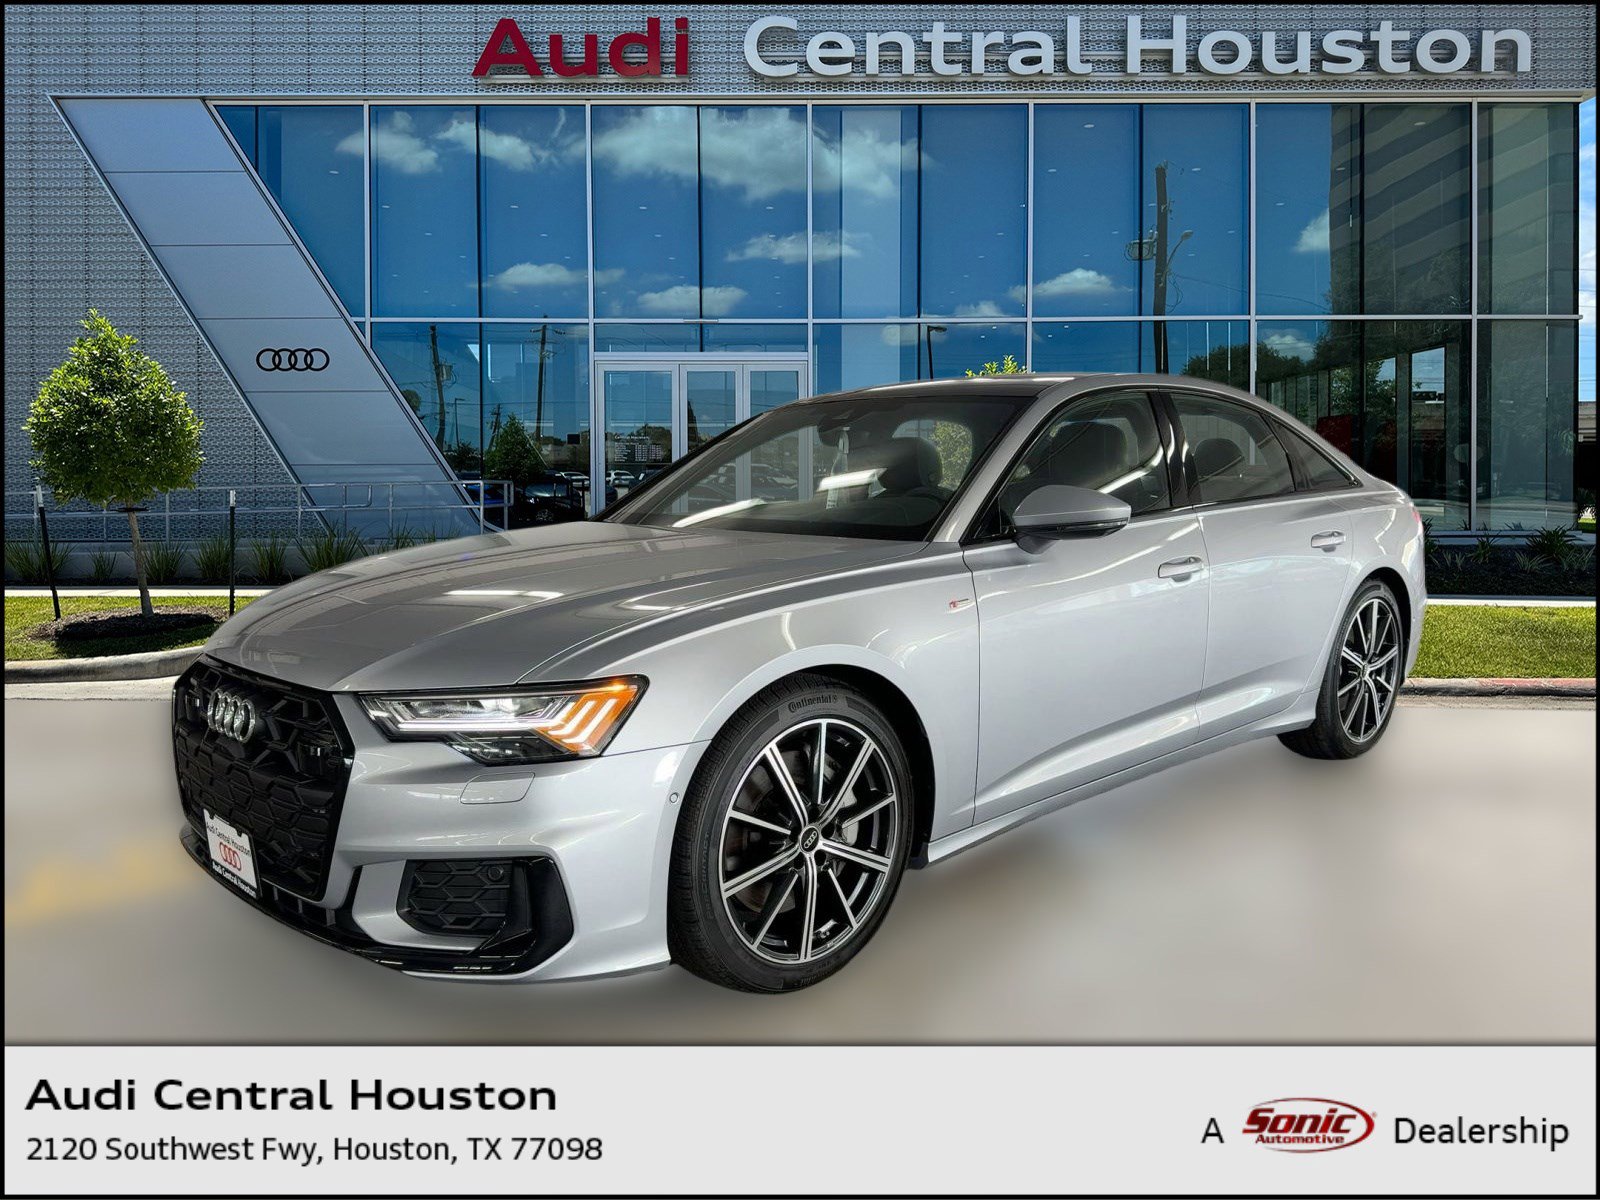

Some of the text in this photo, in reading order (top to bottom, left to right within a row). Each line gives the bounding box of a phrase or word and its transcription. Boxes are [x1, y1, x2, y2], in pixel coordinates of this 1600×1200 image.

[472, 15, 1532, 78] Audi Central Houston
[787, 694, 832, 713] Continental
